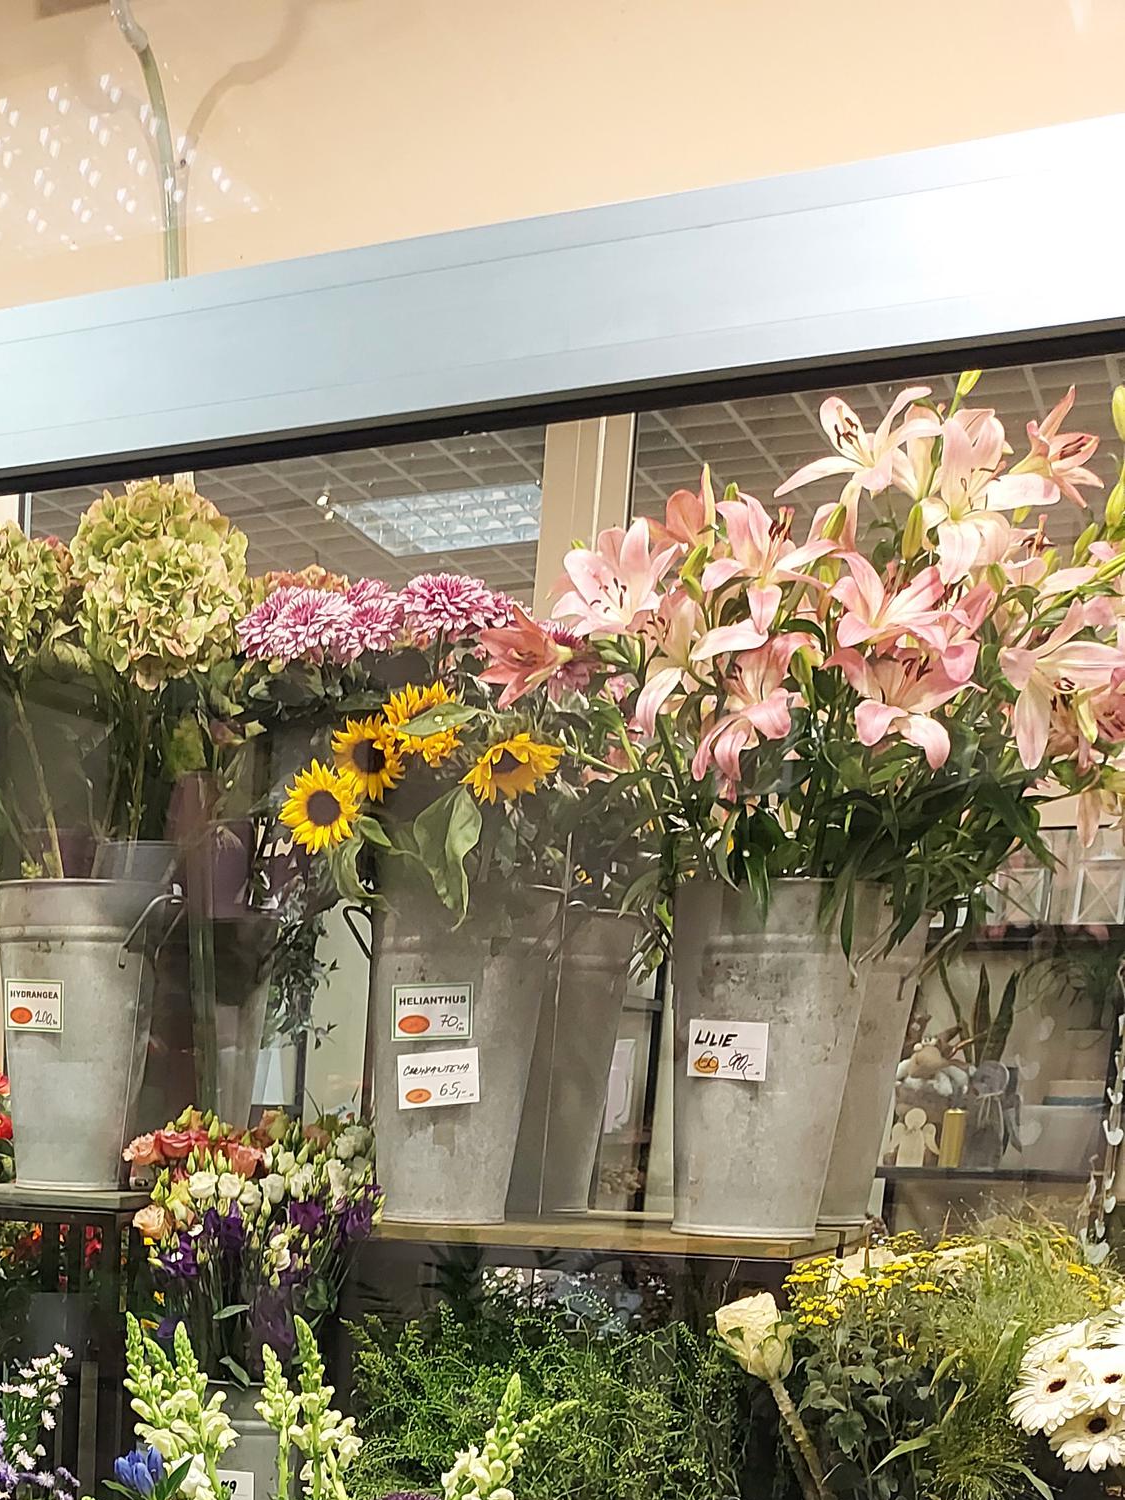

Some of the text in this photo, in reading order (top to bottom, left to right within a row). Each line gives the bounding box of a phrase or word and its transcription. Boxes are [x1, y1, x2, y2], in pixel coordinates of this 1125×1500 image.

[10, 990, 59, 1000] HYDRANGEA
[398, 995, 467, 1006] HELIANTHUS
[694, 1029, 738, 1048] LILIE
